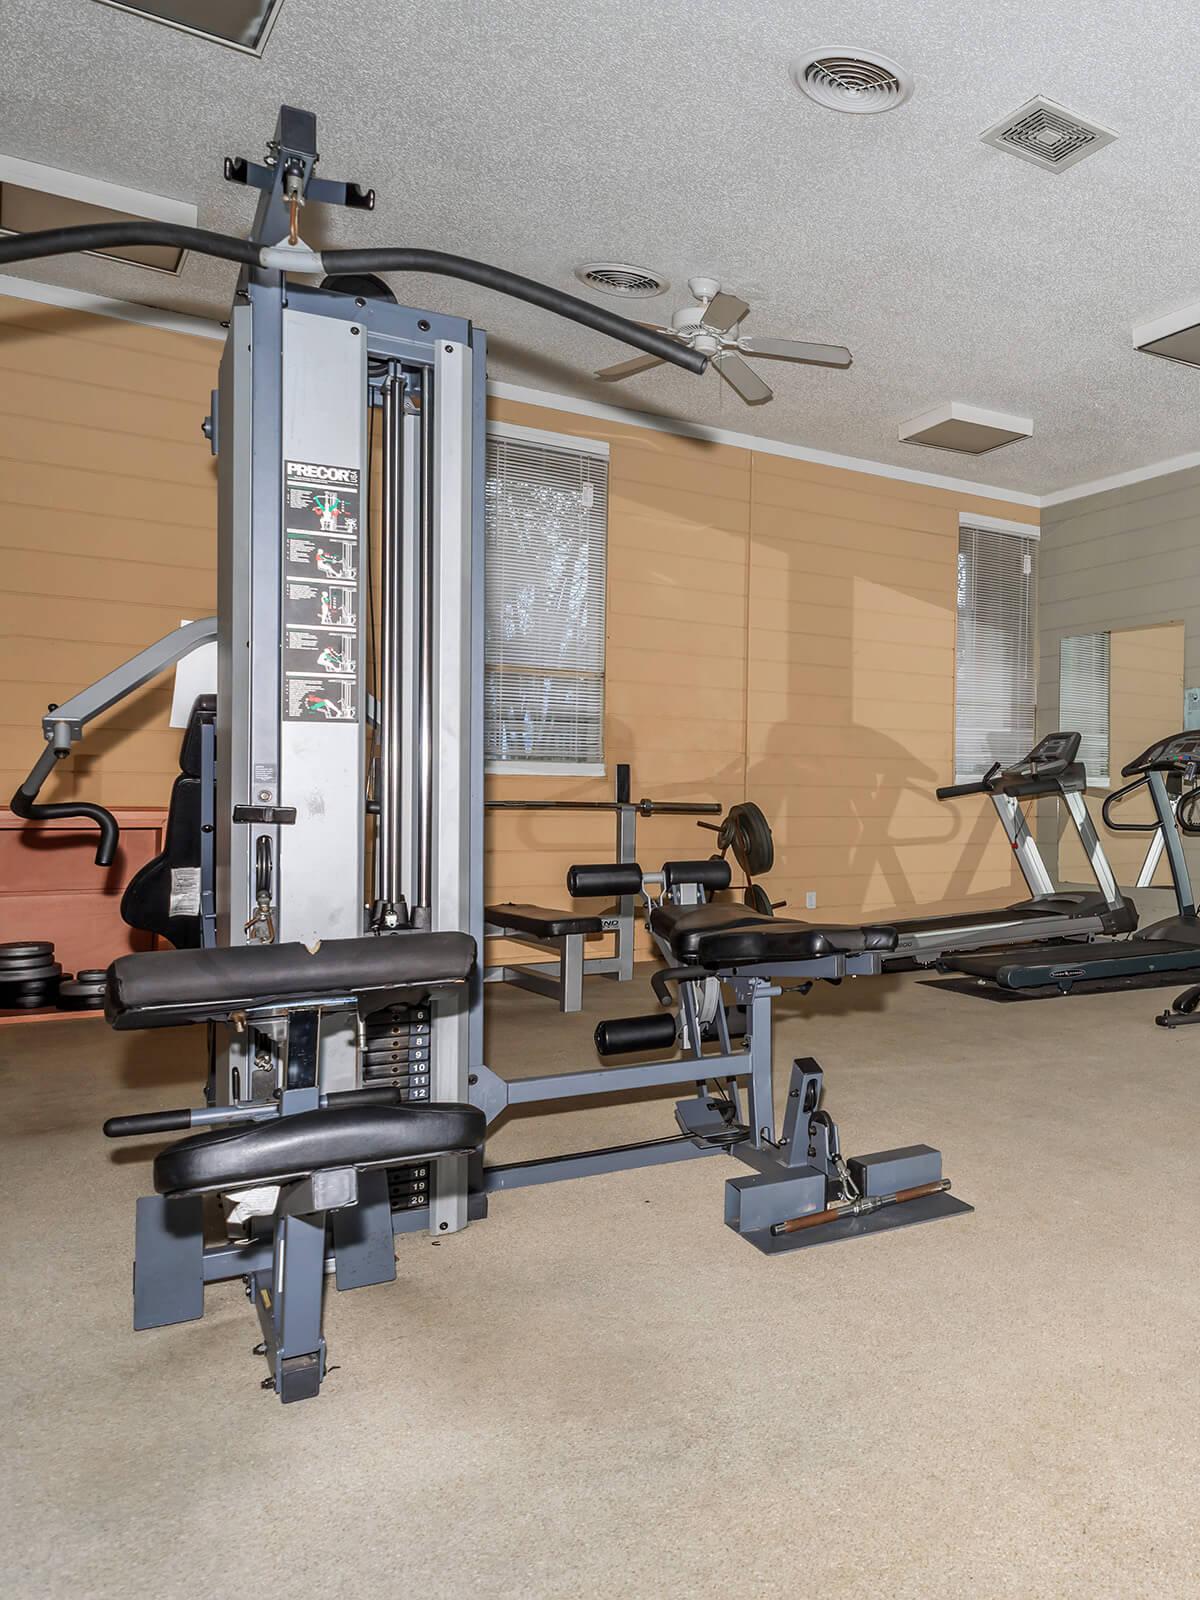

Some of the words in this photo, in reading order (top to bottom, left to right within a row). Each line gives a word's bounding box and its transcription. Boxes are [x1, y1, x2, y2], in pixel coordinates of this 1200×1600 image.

[287, 462, 349, 482] PRECOR
[417, 1011, 424, 1019] 6
[416, 1024, 424, 1032] 7
[416, 1038, 422, 1046] 8
[415, 1051, 422, 1059] 9
[413, 1064, 425, 1072] 10
[413, 1089, 425, 1097] 12
[414, 1168, 426, 1177] 18
[413, 1182, 425, 1190] 19
[411, 1195, 424, 1204] 20
